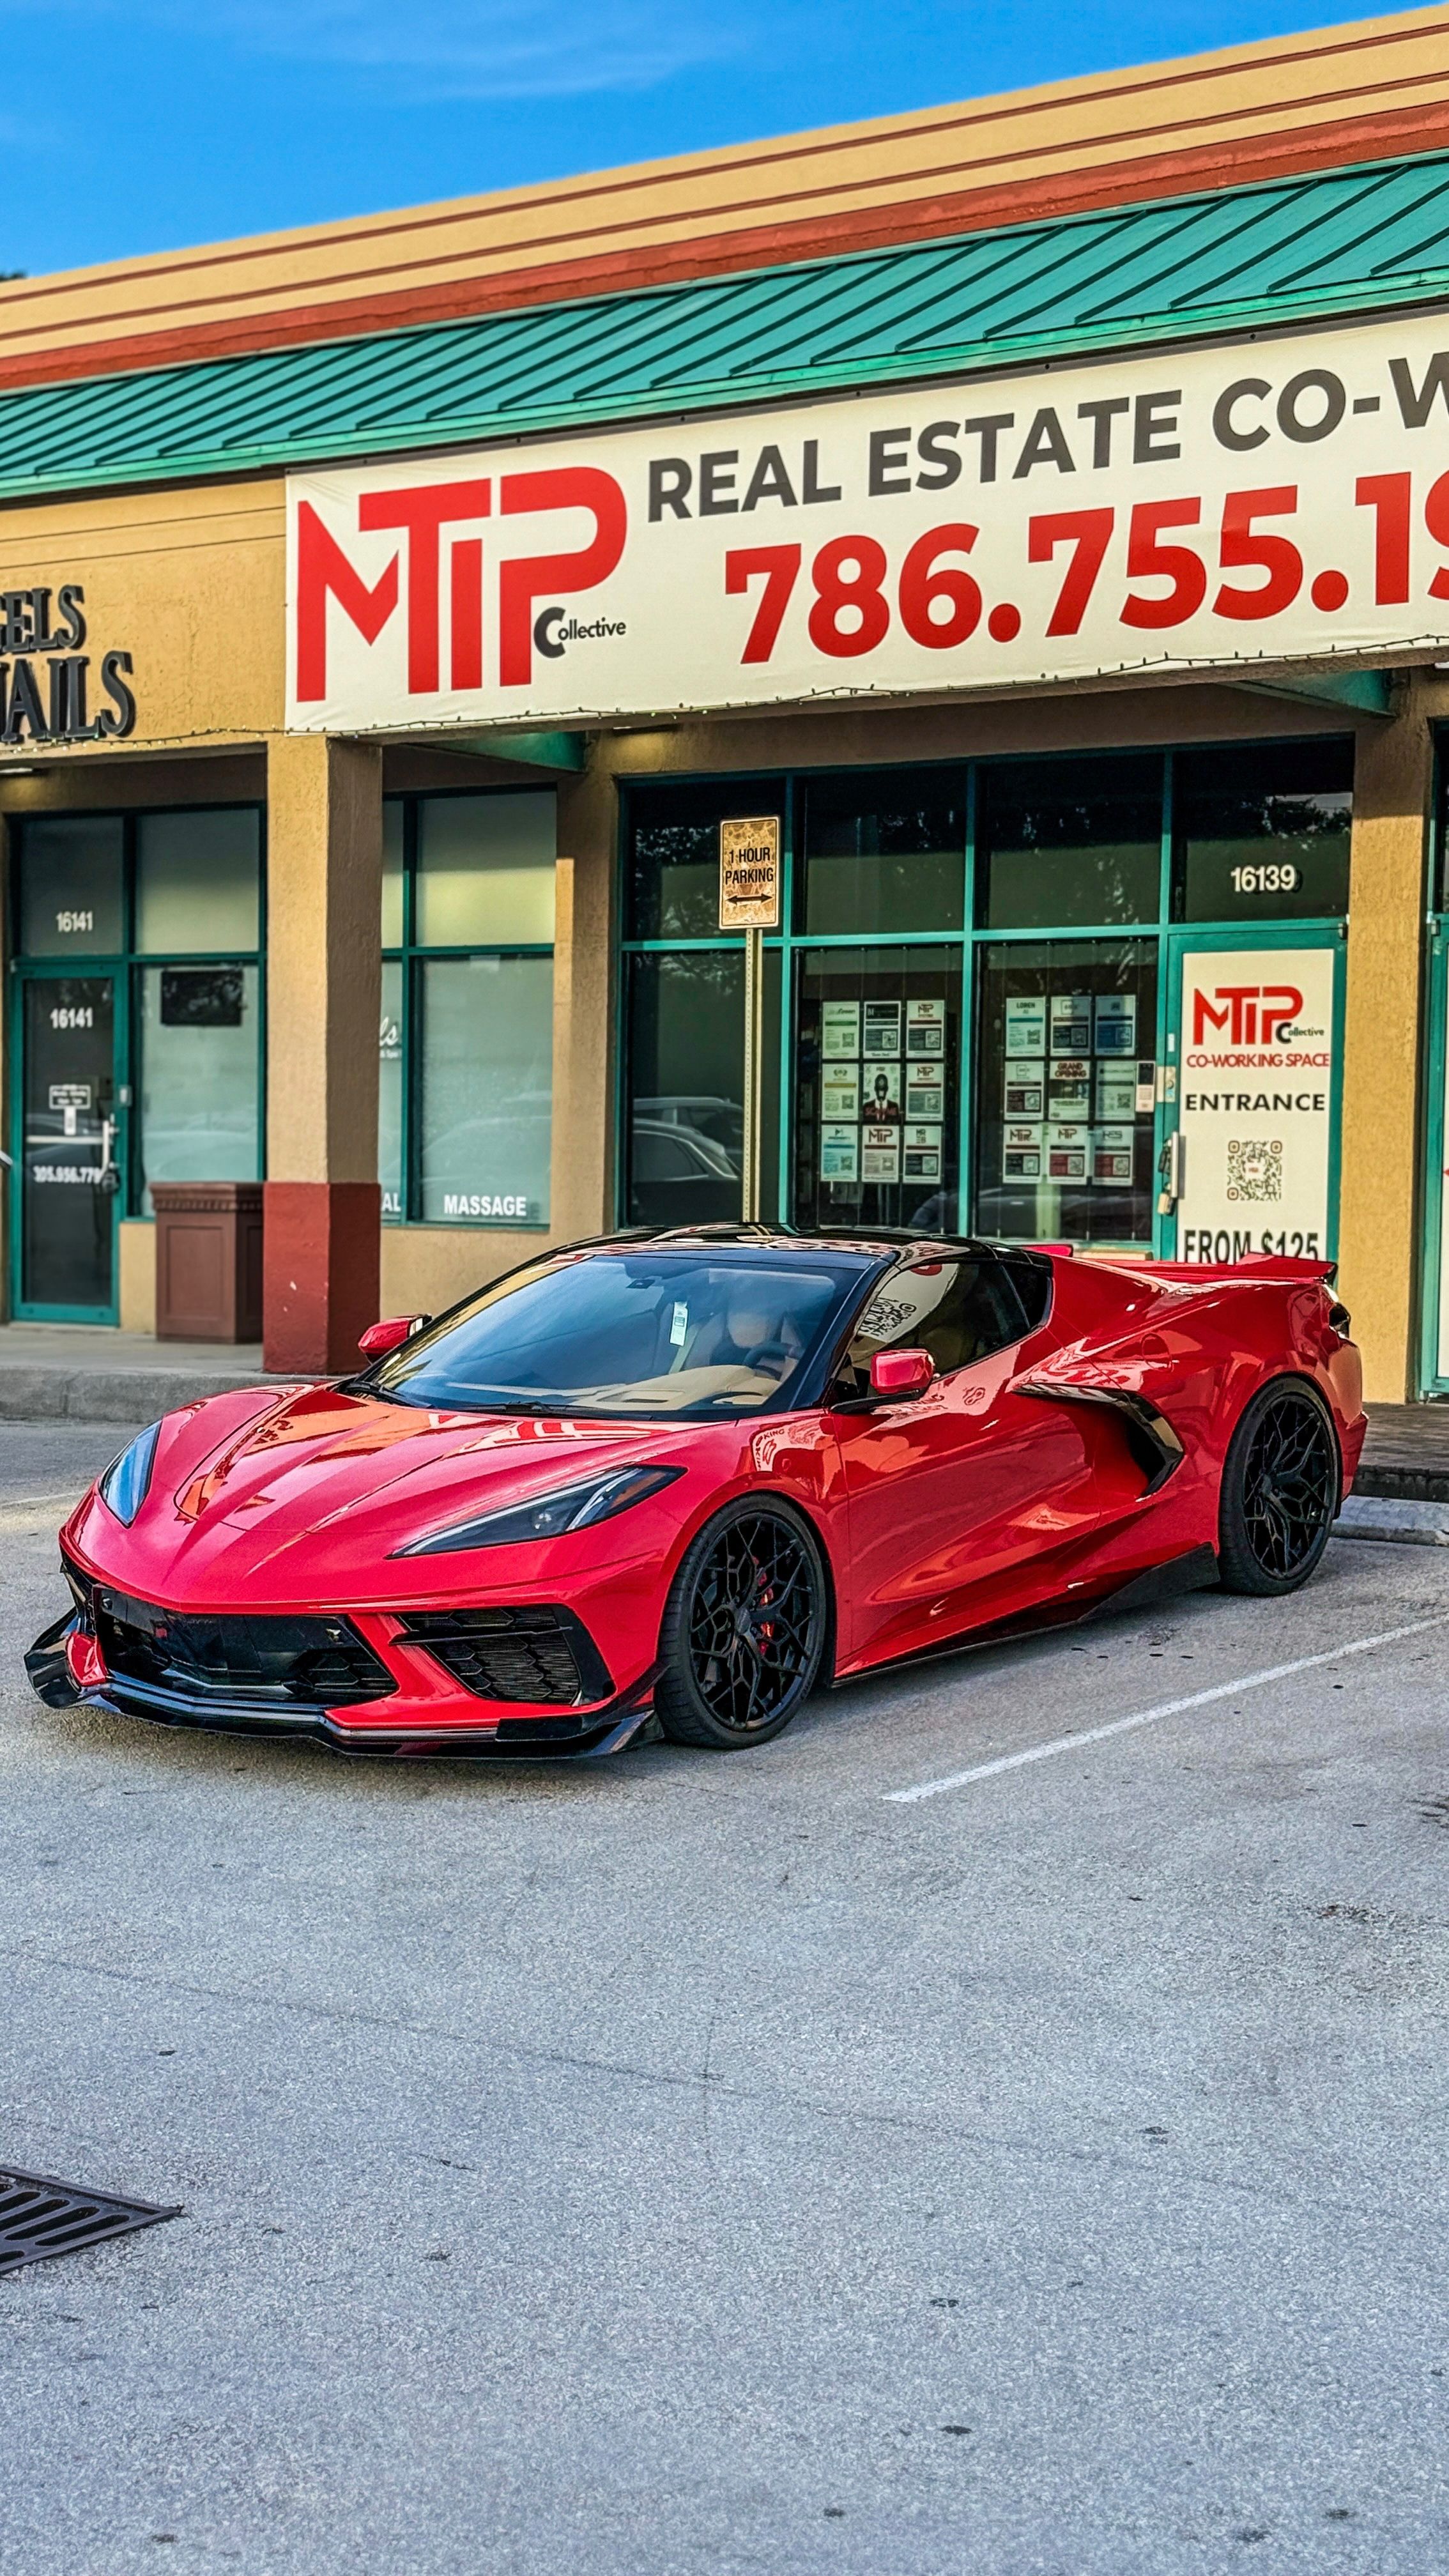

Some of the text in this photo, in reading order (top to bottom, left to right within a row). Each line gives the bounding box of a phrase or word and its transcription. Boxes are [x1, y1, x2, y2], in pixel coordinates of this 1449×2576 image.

[648, 439, 841, 523] REAL
[868, 389, 1183, 497] ESTATE
[0, 584, 87, 654] ELS
[533, 606, 627, 659] Collective
[729, 847, 770, 864] 1 HOUR
[725, 868, 774, 885] PARKING
[1230, 864, 1296, 893] 16139
[56, 911, 93, 932] 16141
[50, 1008, 93, 1029] 16141
[1276, 1022, 1324, 1045] Collective
[1057, 1062, 1084, 1071] GRAND
[1186, 1053, 1330, 1068] CO-WORKING SPACE
[1054, 1070, 1087, 1078] OPENING
[1185, 1093, 1326, 1112] ENTRANCE
[443, 1194, 527, 1216] MASSAGE
[1184, 1228, 1319, 1265] FROM $125
